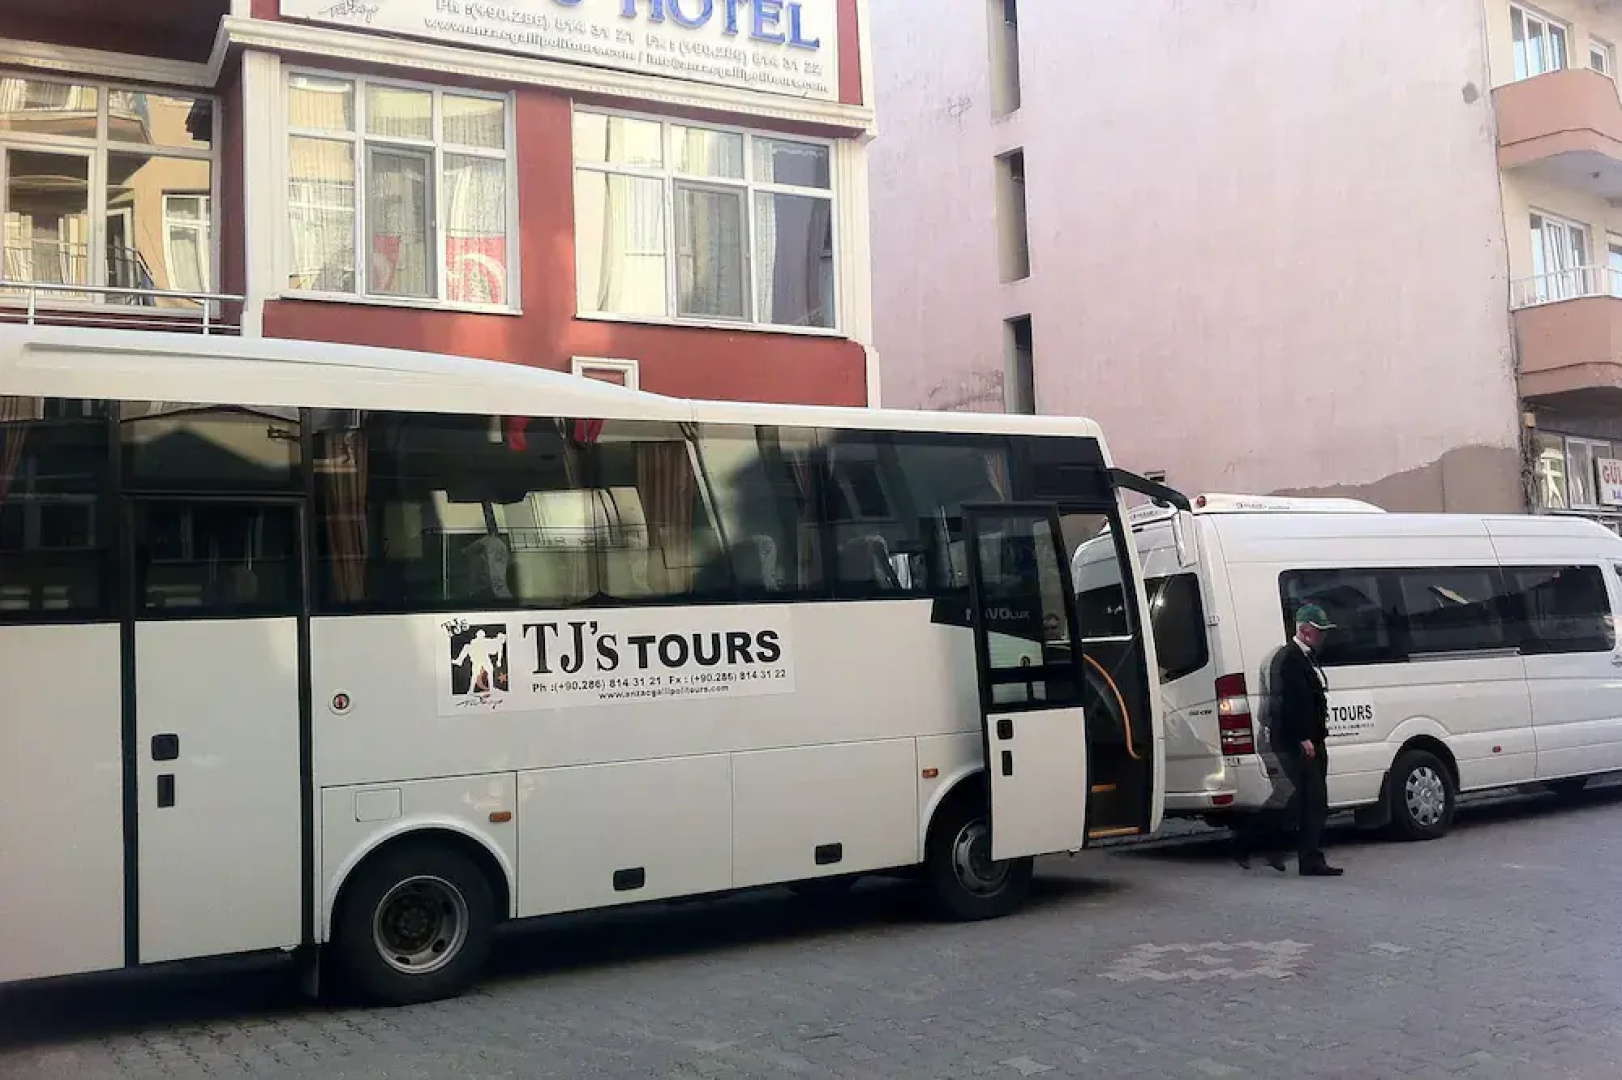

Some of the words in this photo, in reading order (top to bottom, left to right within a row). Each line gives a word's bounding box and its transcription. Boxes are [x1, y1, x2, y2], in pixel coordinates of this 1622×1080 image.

[627, 629, 783, 669] TOURS
[532, 682, 547, 693] Ph
[609, 679, 629, 688] 814
[632, 677, 645, 687] 31
[648, 676, 662, 686] 21
[669, 675, 682, 685] Fx
[739, 671, 757, 681] 814
[760, 670, 771, 679] 31
[774, 668, 786, 678] 22
[1331, 704, 1373, 722] TOURS
